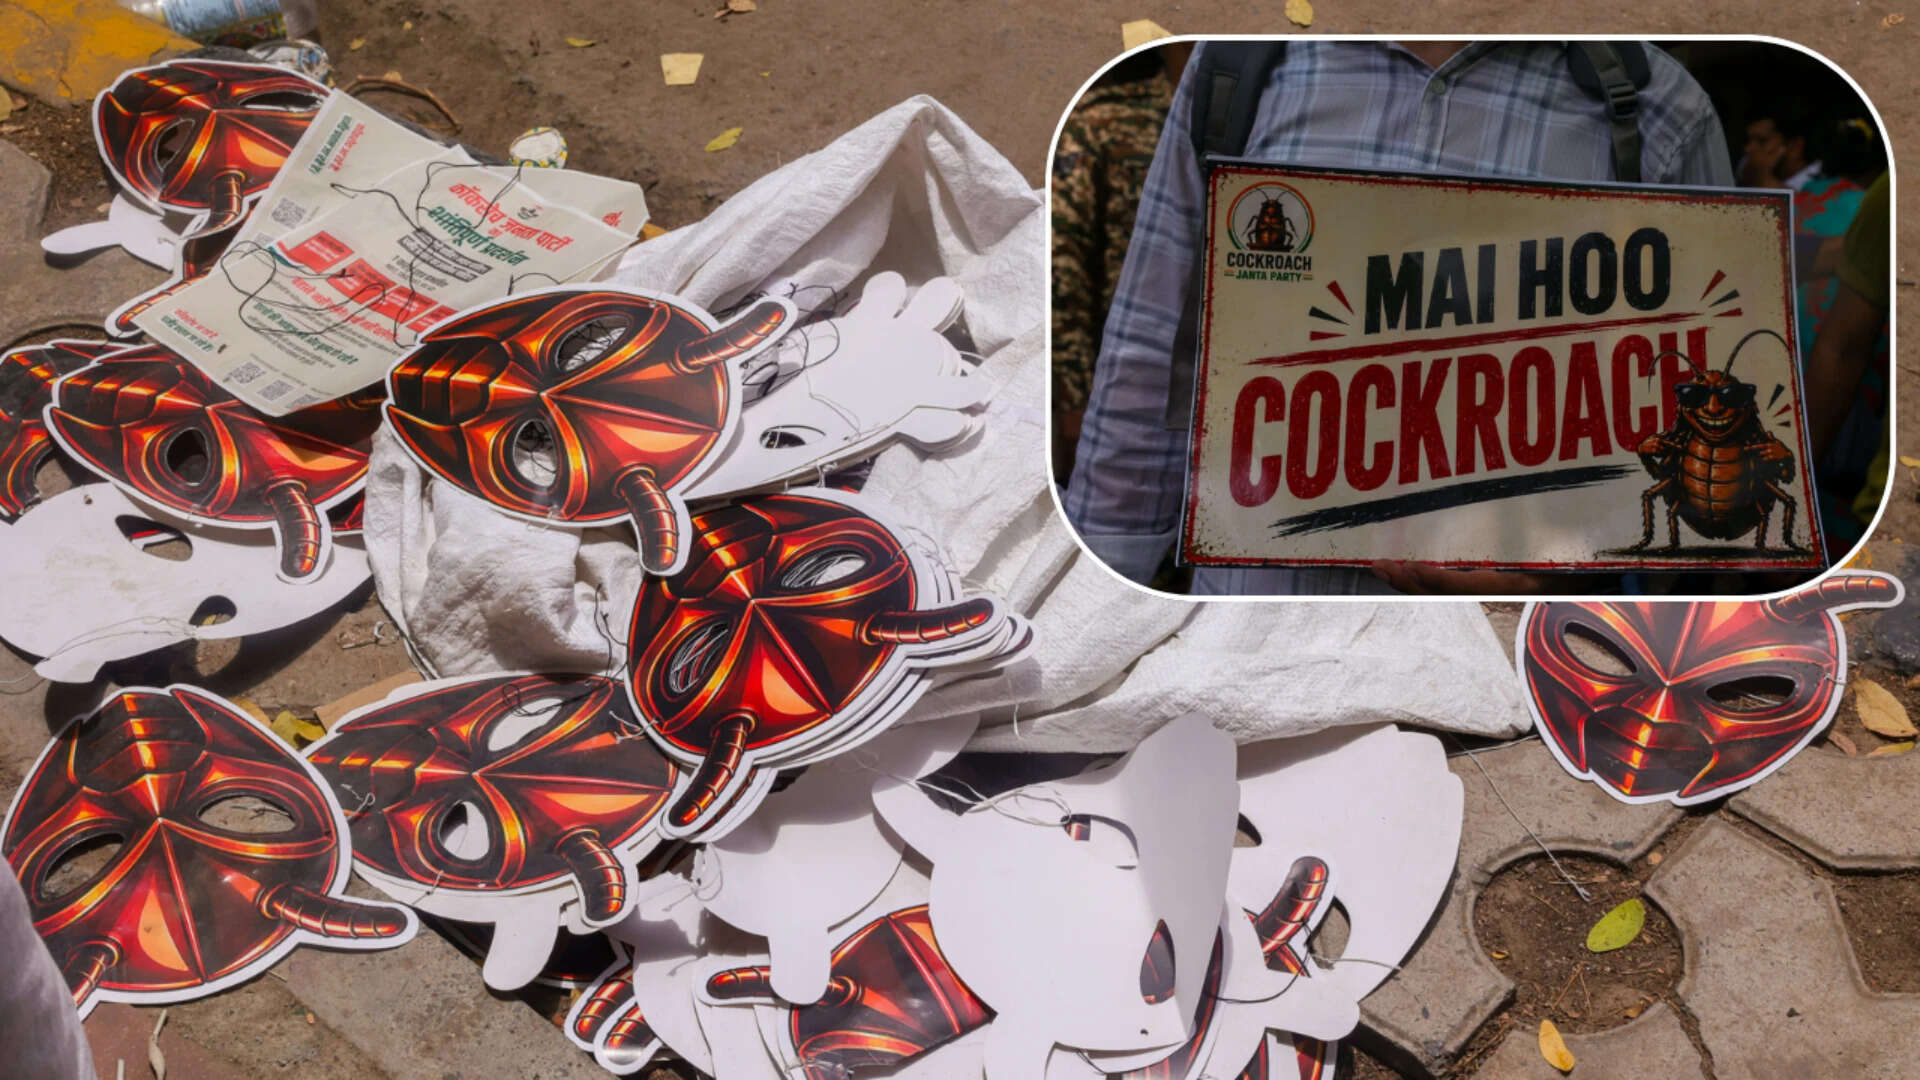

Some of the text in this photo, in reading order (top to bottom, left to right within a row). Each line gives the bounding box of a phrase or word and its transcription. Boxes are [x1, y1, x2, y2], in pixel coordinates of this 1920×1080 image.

[449, 182, 574, 253] कॉकरोच जनता पार्टी
[1227, 252, 1312, 271] COCKROACH
[1236, 270, 1302, 283] JANTA PARTY
[1364, 227, 1671, 335] MAI HOO
